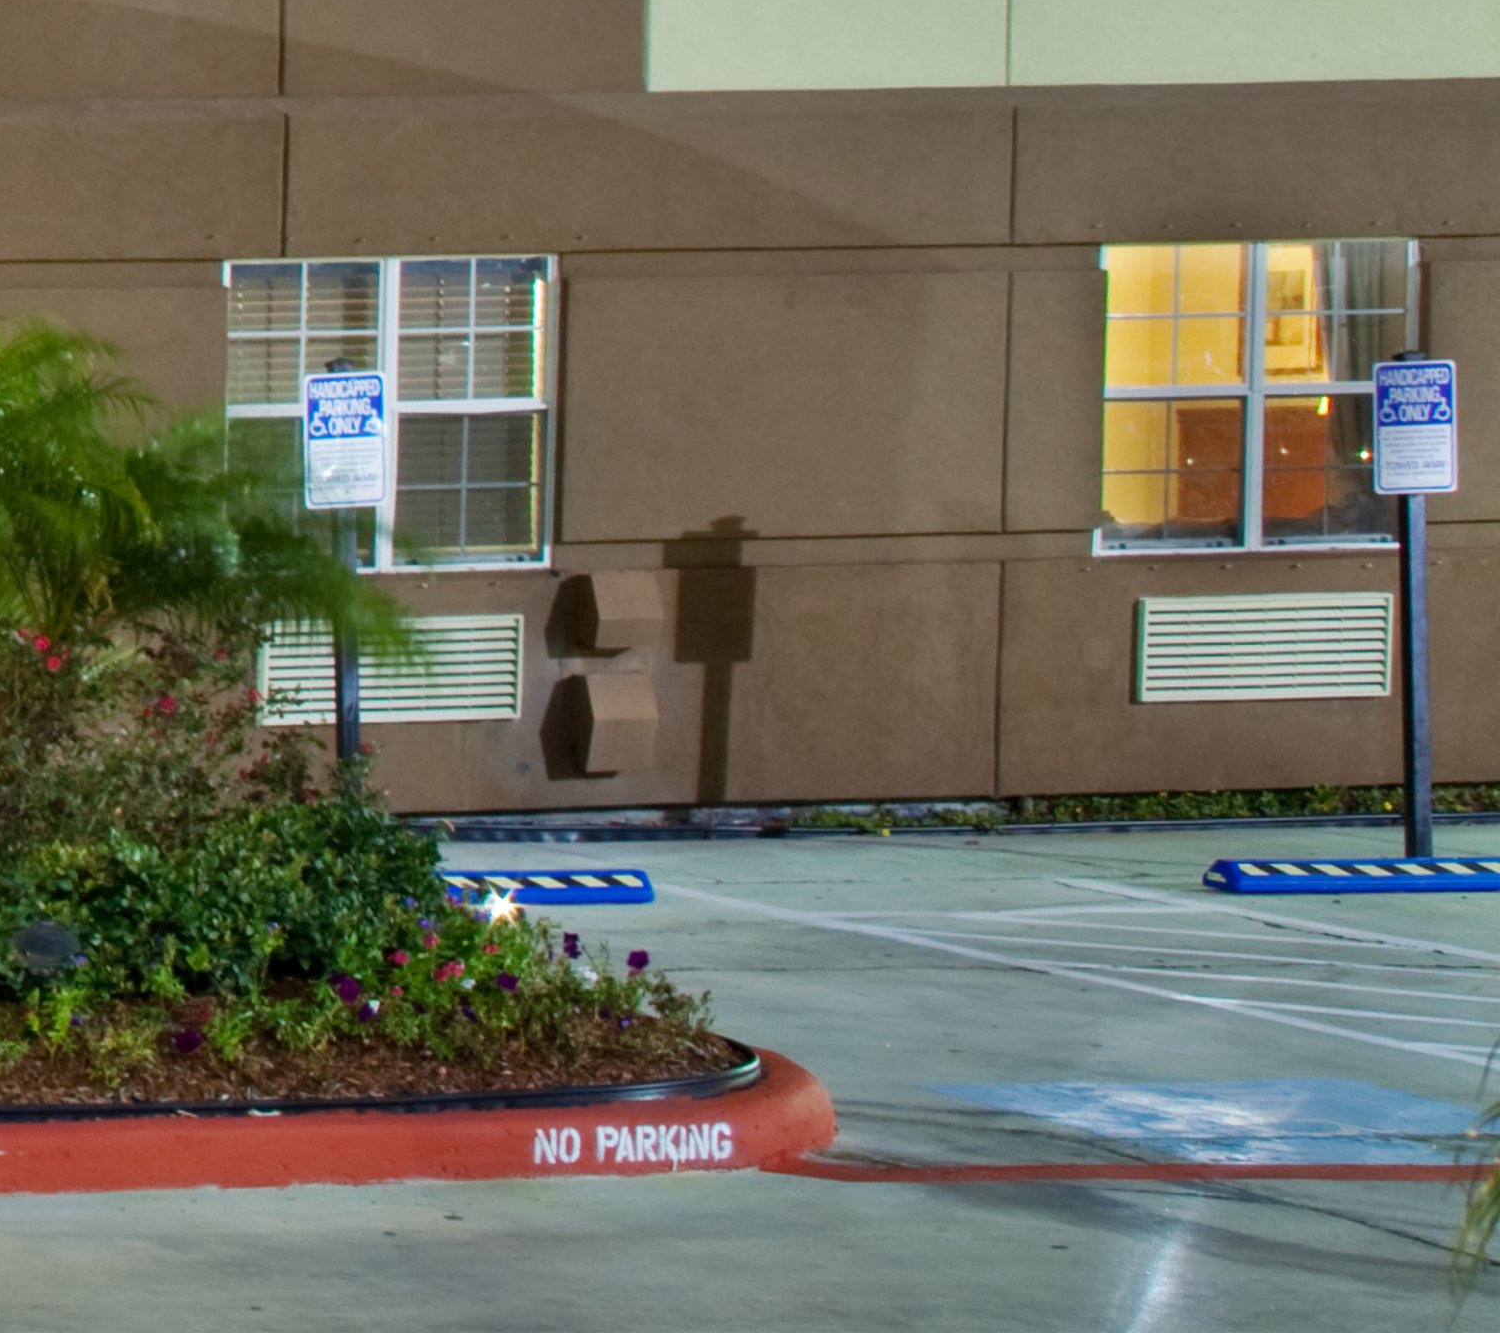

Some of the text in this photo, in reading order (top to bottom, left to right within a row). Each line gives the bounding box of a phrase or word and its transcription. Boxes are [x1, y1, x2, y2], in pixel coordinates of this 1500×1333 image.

[1379, 367, 1450, 386] HANDICAPPED
[309, 378, 381, 399] HANDICAPPED
[1389, 386, 1441, 403] PARKING
[318, 398, 371, 417] PARKING
[1398, 404, 1431, 421] ONLY
[328, 416, 362, 435] ONLY
[533, 1122, 733, 1165] NO PARKING
